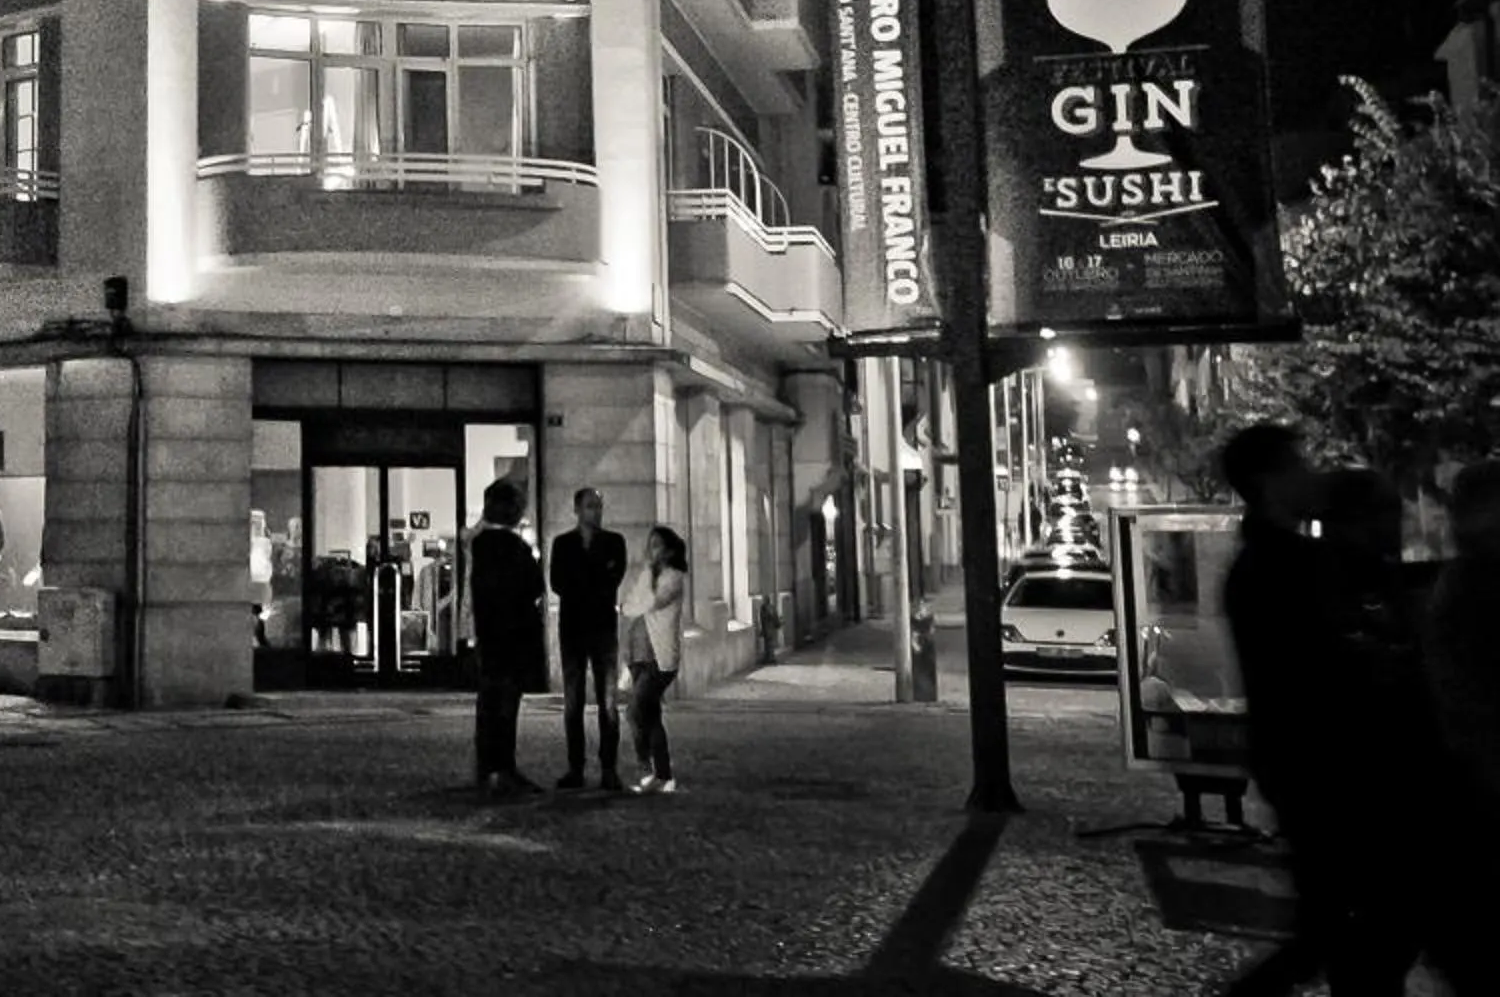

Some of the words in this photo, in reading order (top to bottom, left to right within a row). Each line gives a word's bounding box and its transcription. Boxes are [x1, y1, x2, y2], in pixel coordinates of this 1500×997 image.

[843, 93, 862, 153] CENTRO
[873, 50, 909, 171] MIGUEL
[1051, 79, 1195, 135] GIN
[847, 155, 868, 232] CULTURAL
[1056, 171, 1203, 208] SUSHI
[881, 176, 919, 304] FRANCO
[1087, 254, 1103, 268] 17
[1099, 232, 1160, 249] LEIRIA
